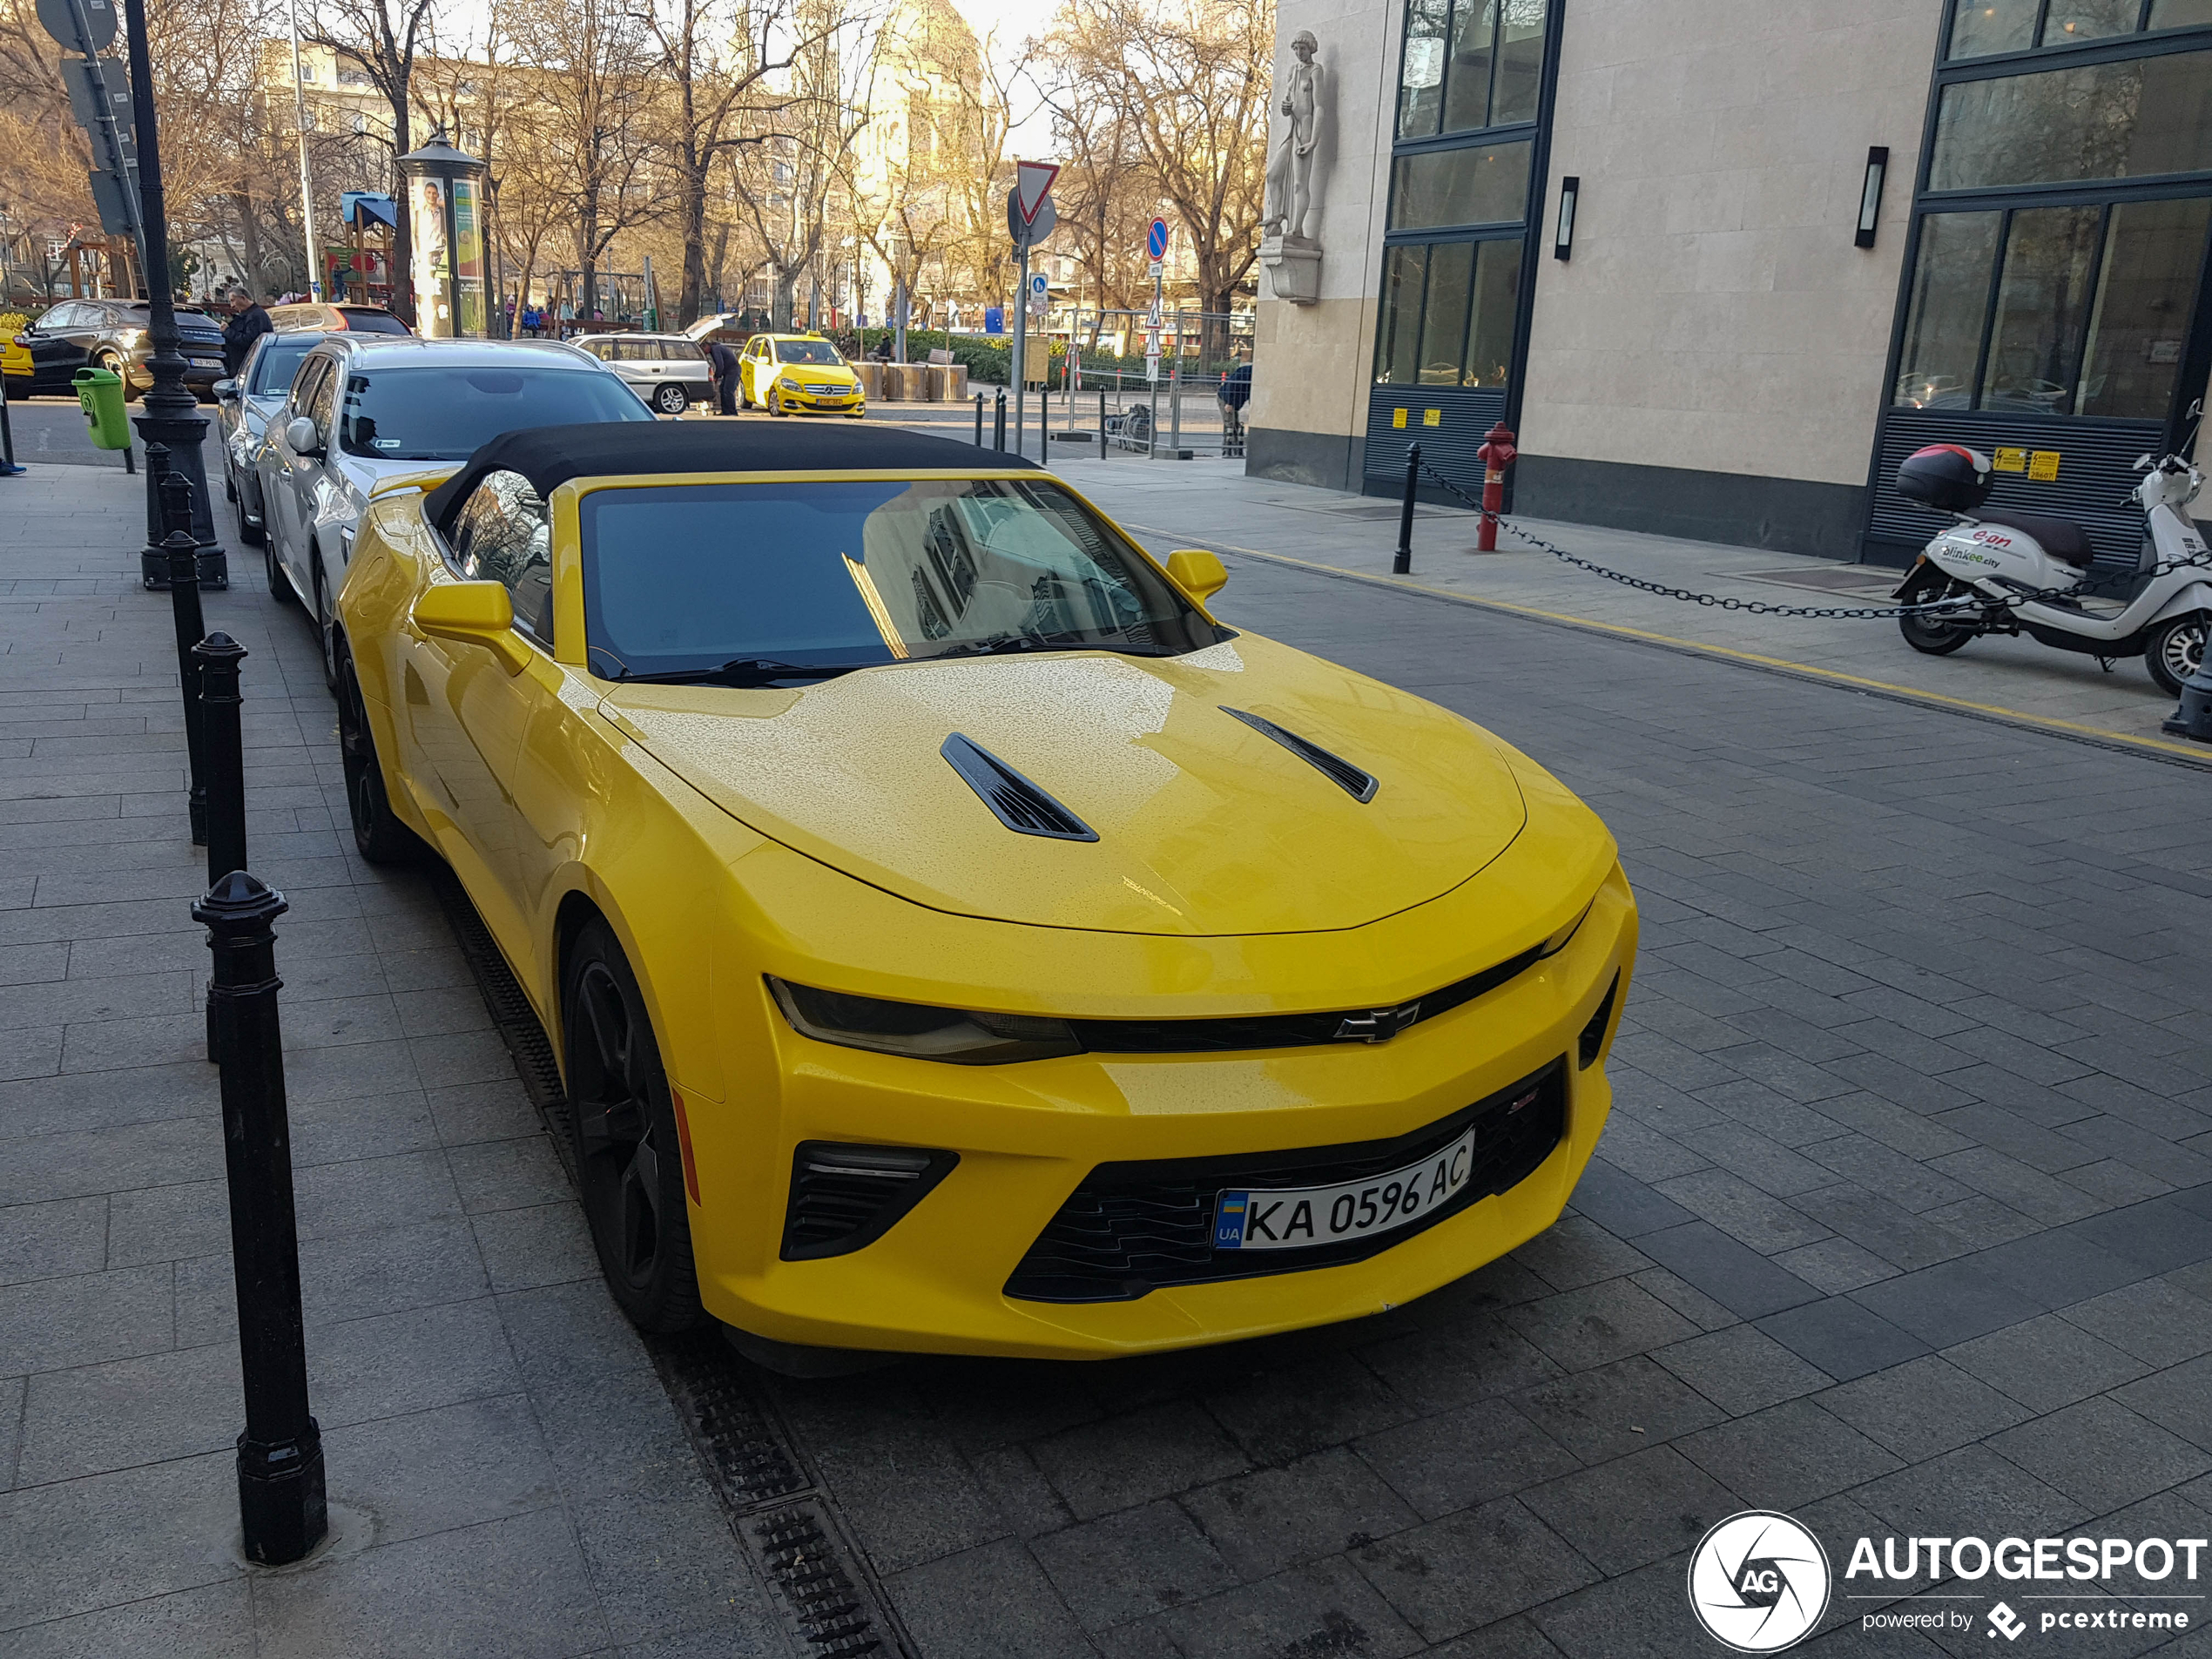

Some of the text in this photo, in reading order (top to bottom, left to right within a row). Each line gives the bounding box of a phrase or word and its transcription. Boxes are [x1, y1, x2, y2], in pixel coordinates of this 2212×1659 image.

[1943, 546, 2000, 568] blinkee.city
[1244, 1144, 1467, 1241] KA 0596 AC
[1219, 1228, 1240, 1240] UA
